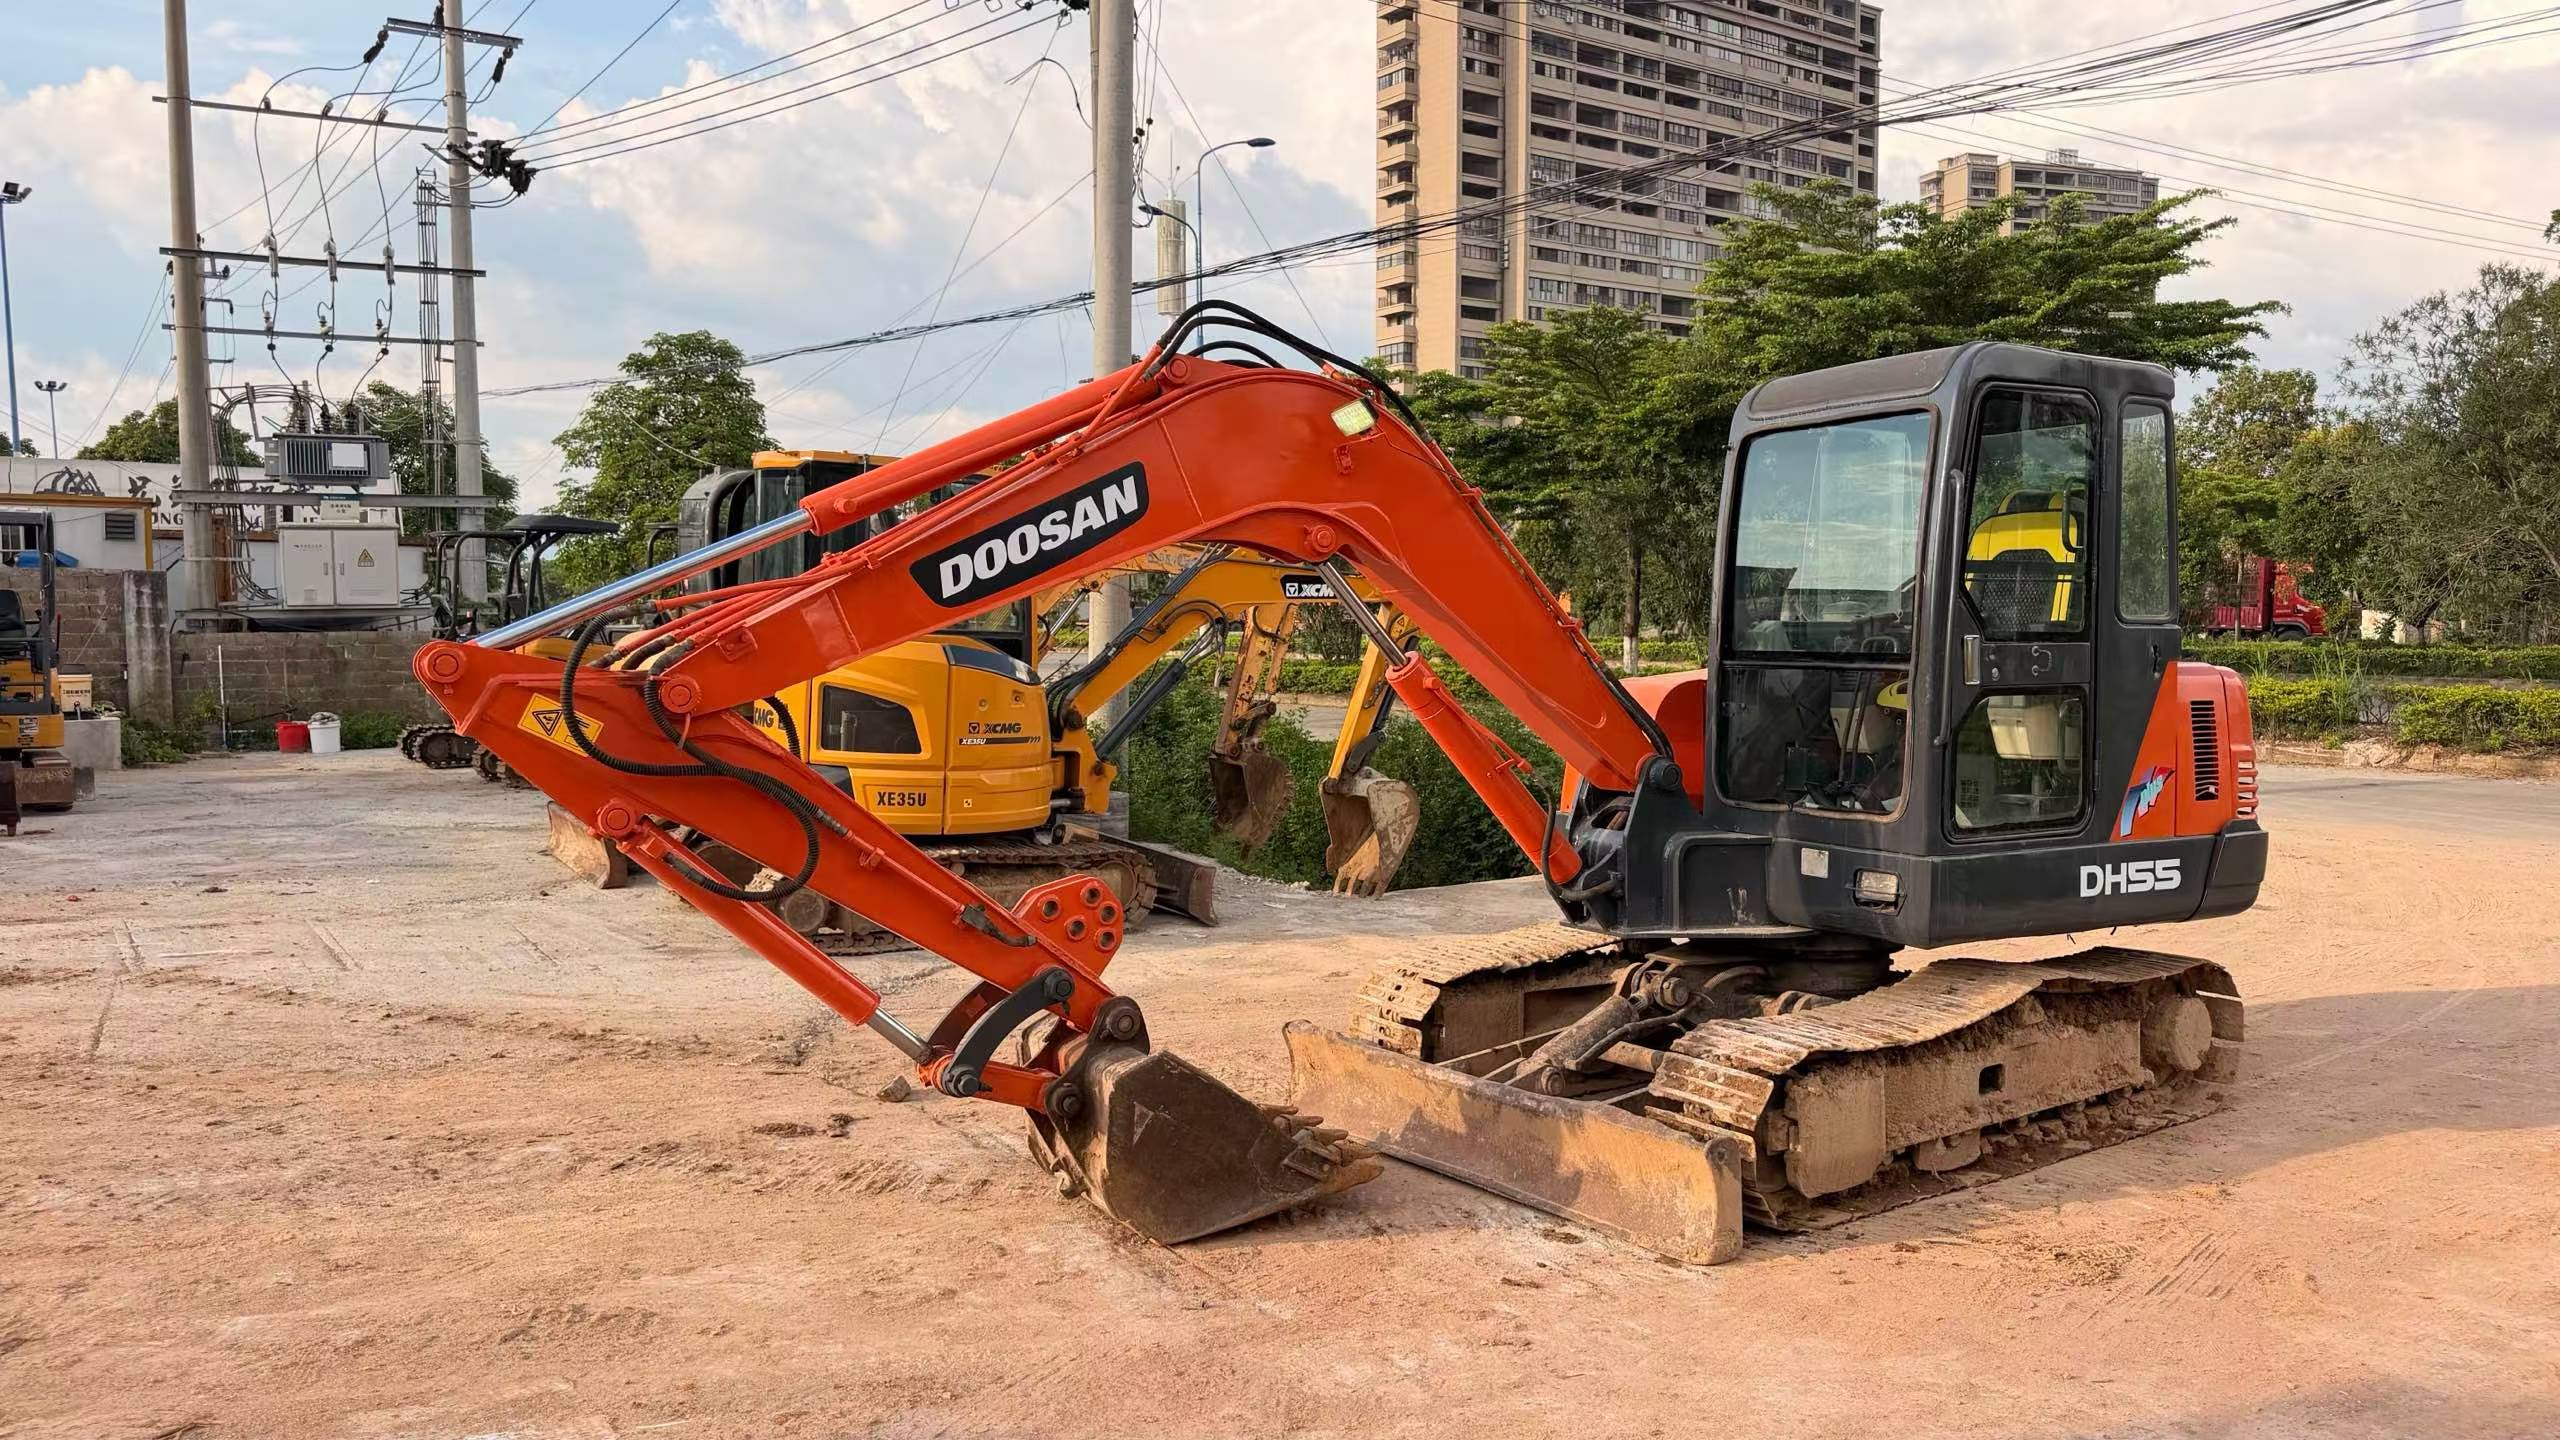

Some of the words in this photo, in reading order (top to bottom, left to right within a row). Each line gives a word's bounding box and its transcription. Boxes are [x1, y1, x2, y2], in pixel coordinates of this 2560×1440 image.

[939, 475, 1138, 599] DOOSAN
[983, 722, 1022, 735] XCMG
[877, 791, 927, 807] XE35U
[2079, 858, 2182, 898] DH55
